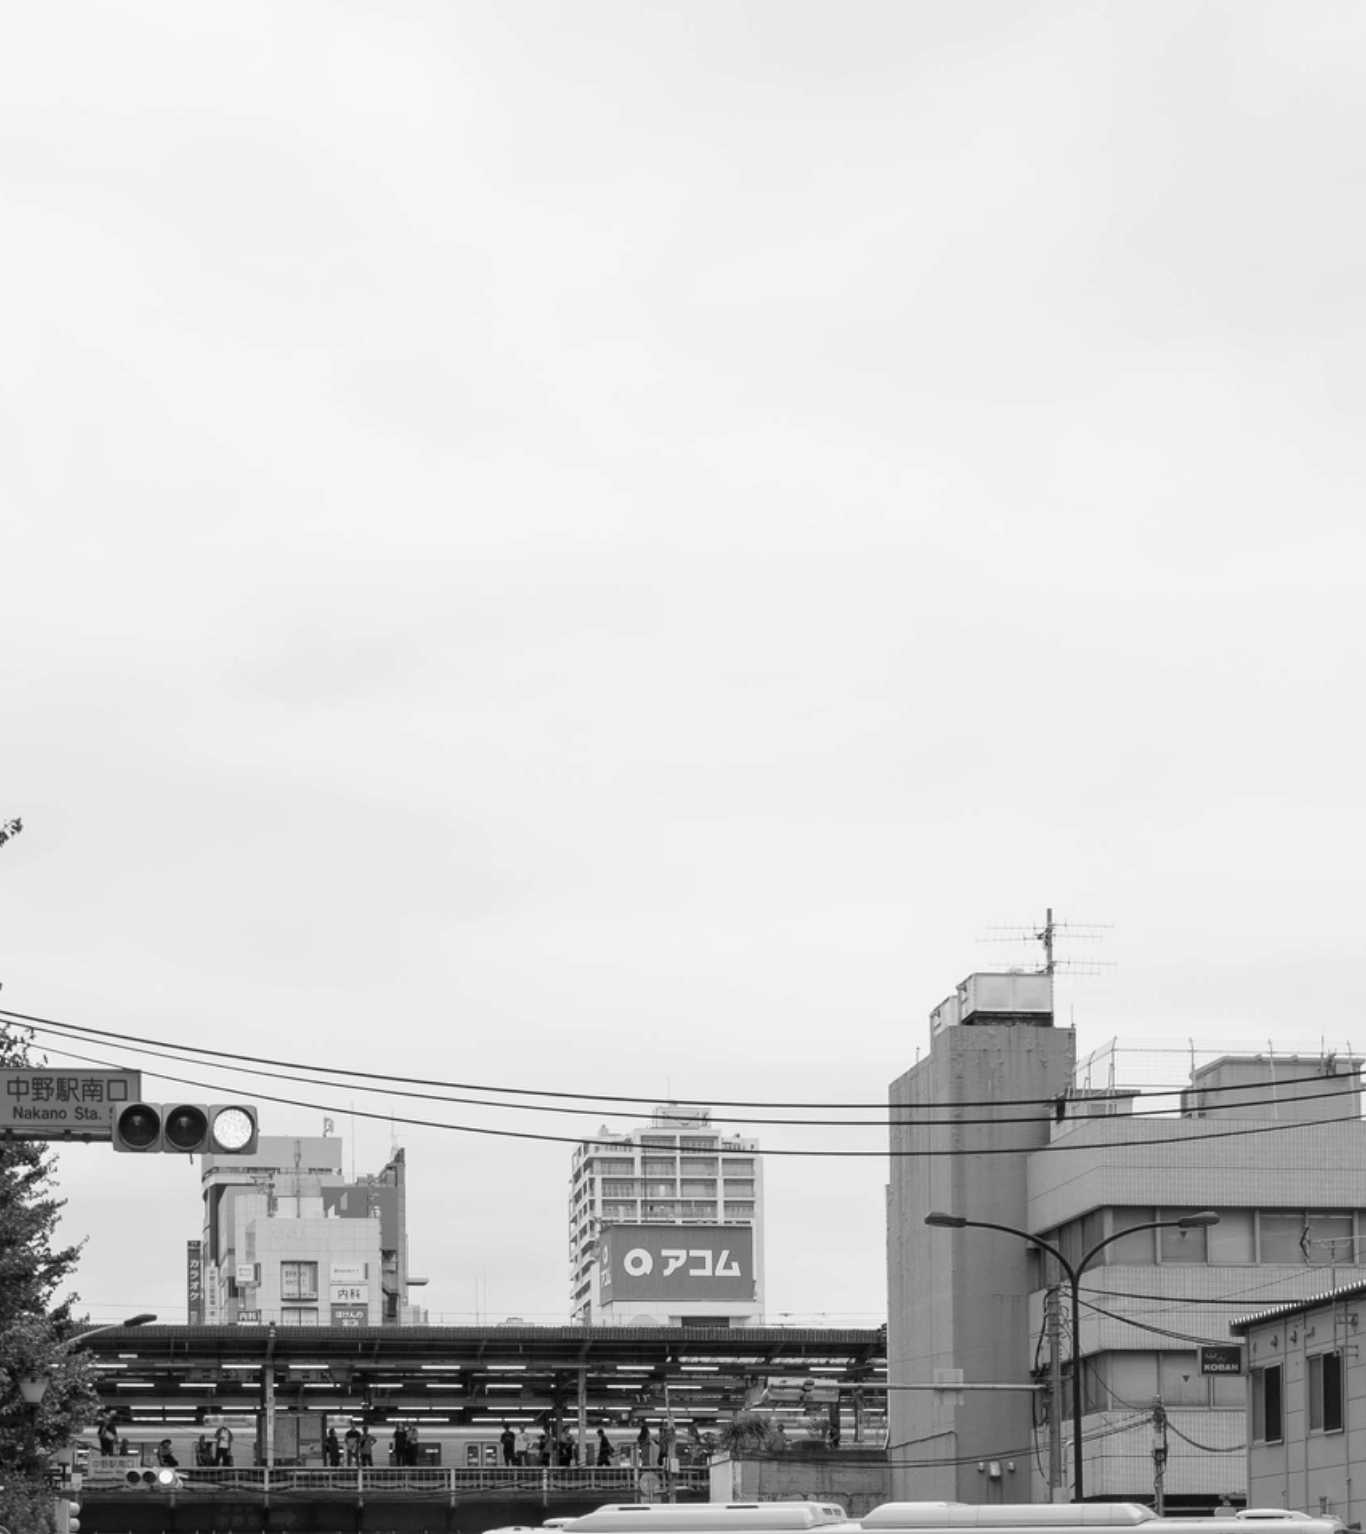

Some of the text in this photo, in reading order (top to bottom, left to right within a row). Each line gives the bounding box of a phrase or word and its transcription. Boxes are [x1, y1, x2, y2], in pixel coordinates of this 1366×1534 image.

[6, 1076, 128, 1103] 中野駅南口
[13, 1106, 67, 1121] Nakano
[74, 1106, 102, 1121] Sta.
[660, 1249, 742, 1277] アコム
[189, 1259, 200, 1301] カラオケ
[337, 1288, 360, 1300] 内科
[1204, 1363, 1239, 1371] KOBAN
